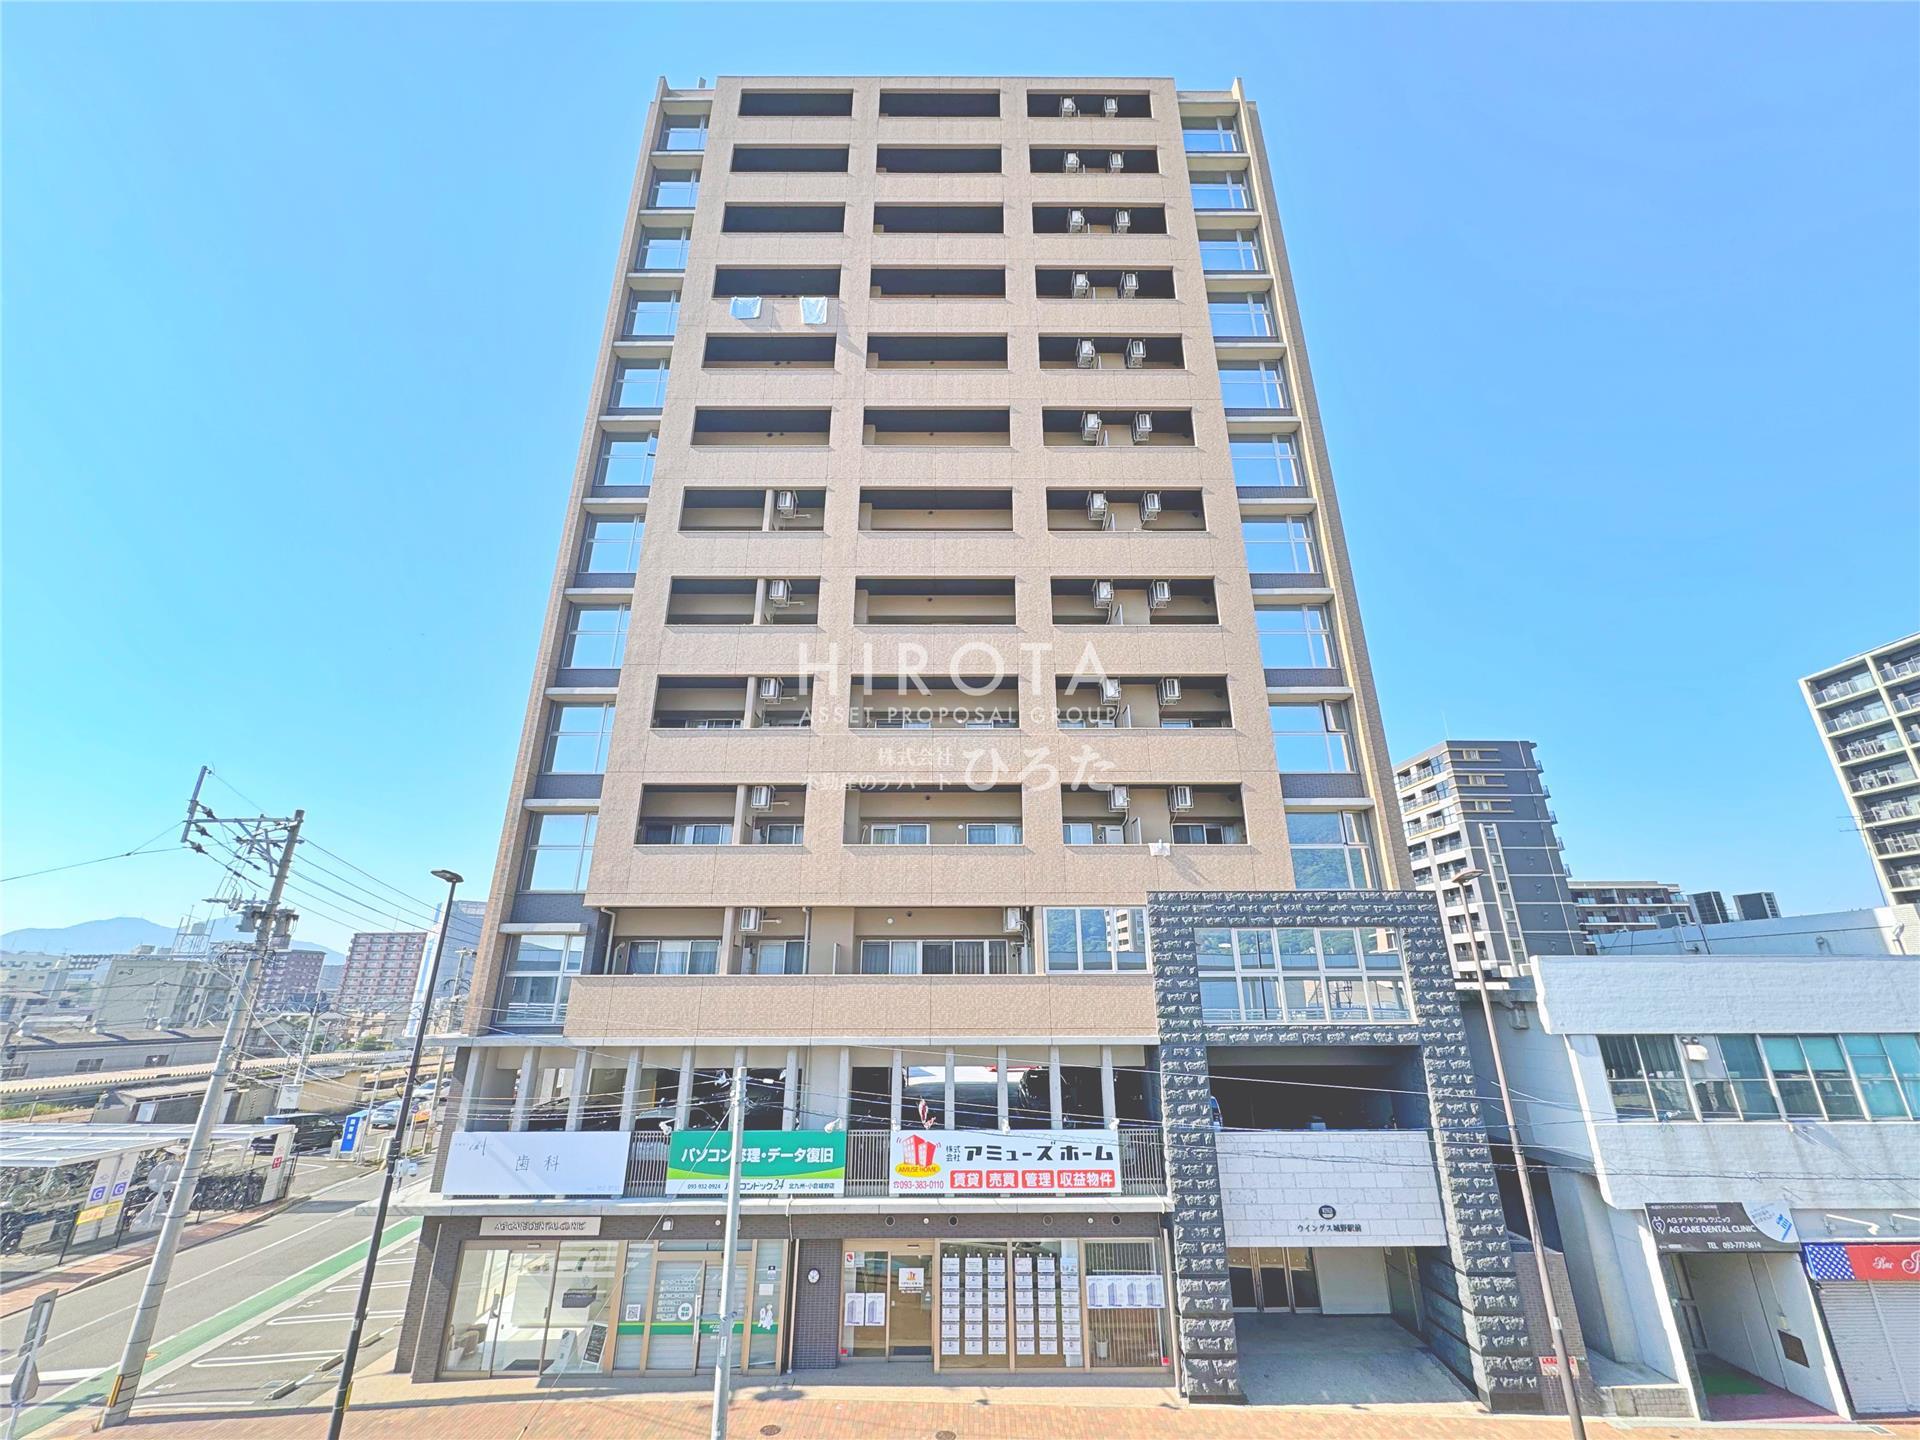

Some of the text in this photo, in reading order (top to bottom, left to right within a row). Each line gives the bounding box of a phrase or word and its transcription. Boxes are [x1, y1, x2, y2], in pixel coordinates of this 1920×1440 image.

[964, 1140, 1114, 1162] アミューズホーム
[515, 1154, 560, 1172] 歯科
[953, 1173, 1113, 1187] 賃貸 売買 管理 収益物件
[1669, 1225, 1757, 1233] AG CARE DENTAL CLINIC
[1707, 1241, 1719, 1249] TEL
